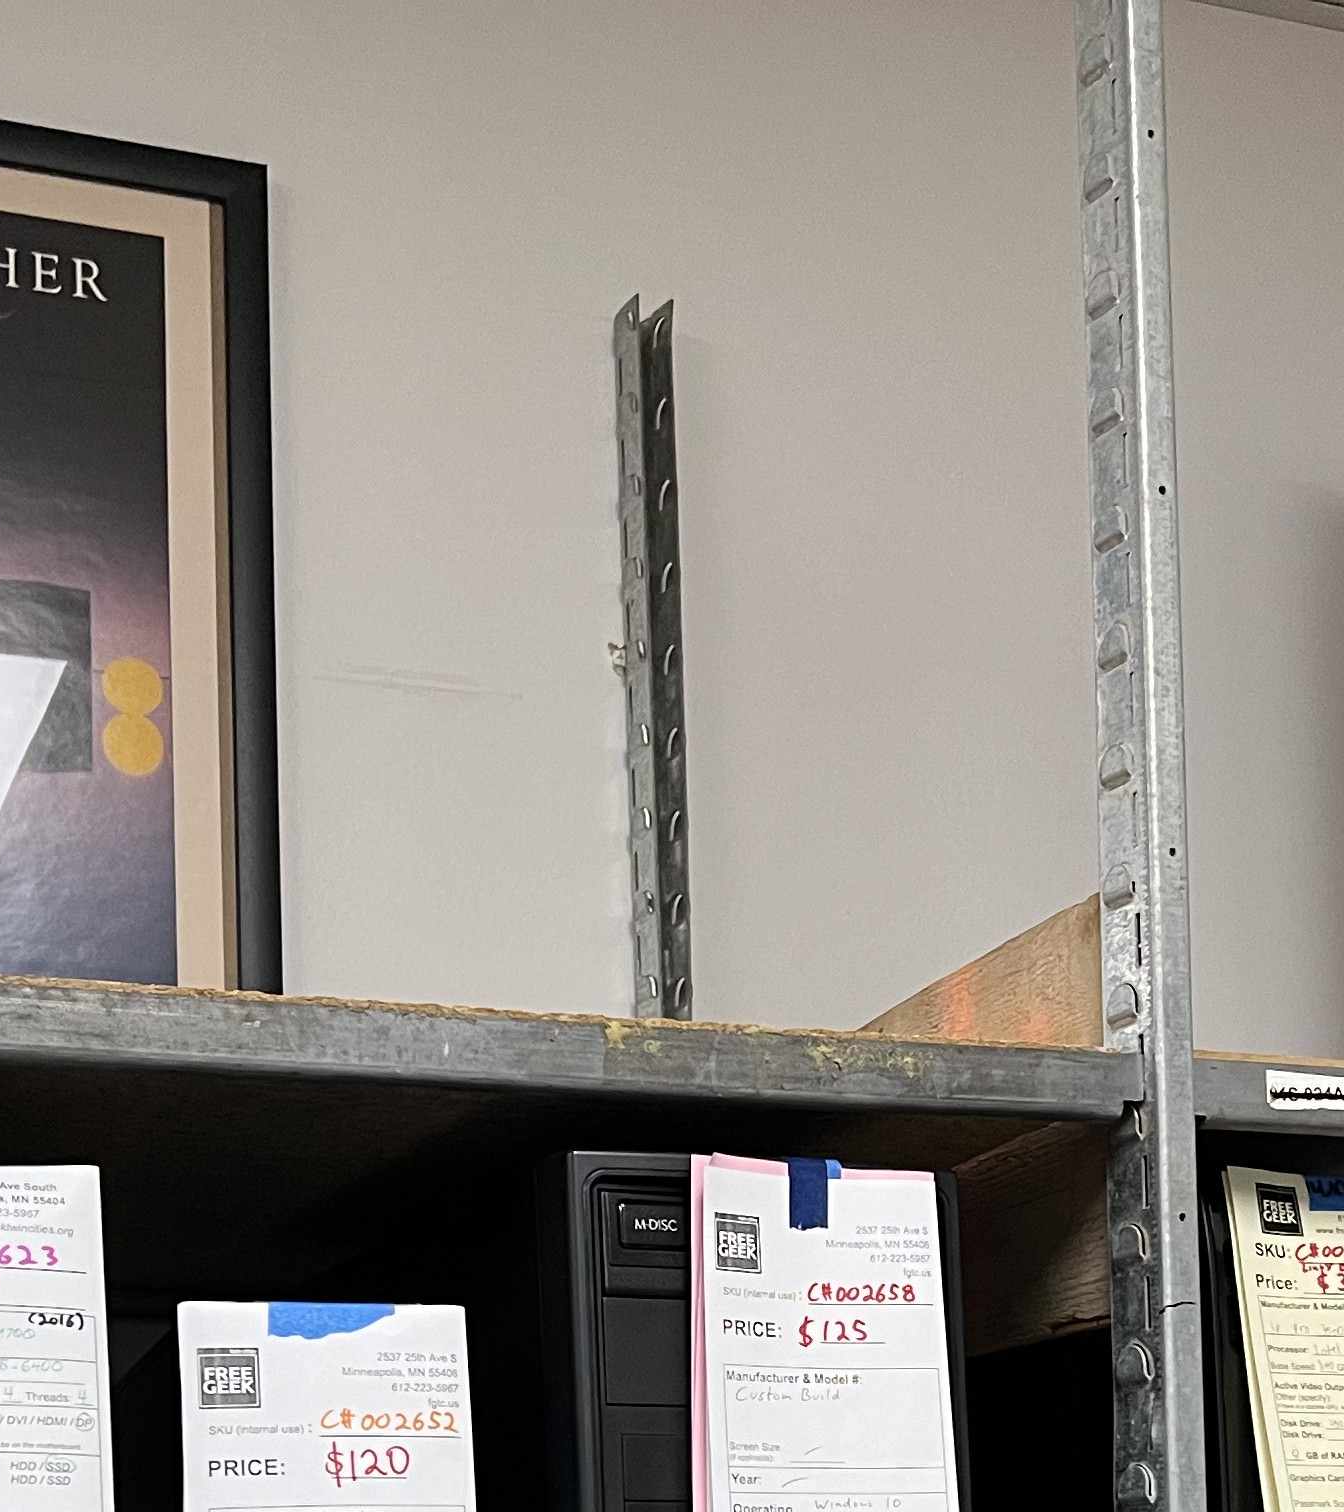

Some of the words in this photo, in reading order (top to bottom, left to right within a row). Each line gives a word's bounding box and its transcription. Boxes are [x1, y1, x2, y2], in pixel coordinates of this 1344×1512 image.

[24, 1182, 57, 1192] South
[1263, 1200, 1293, 1210] FREE
[1263, 1211, 1297, 1224] GEEK
[718, 1230, 755, 1246] FREE
[718, 1245, 757, 1260] GEEK
[1255, 1243, 1291, 1258] SKU:
[1256, 1274, 1298, 1290] Price:
[723, 1319, 782, 1338] PRICE:
[798, 1316, 868, 1348] $125
[204, 1367, 254, 1381] FREE
[202, 1380, 255, 1394] GEEK
[208, 1459, 285, 1477] PRICE:
[325, 1441, 410, 1488] $120
